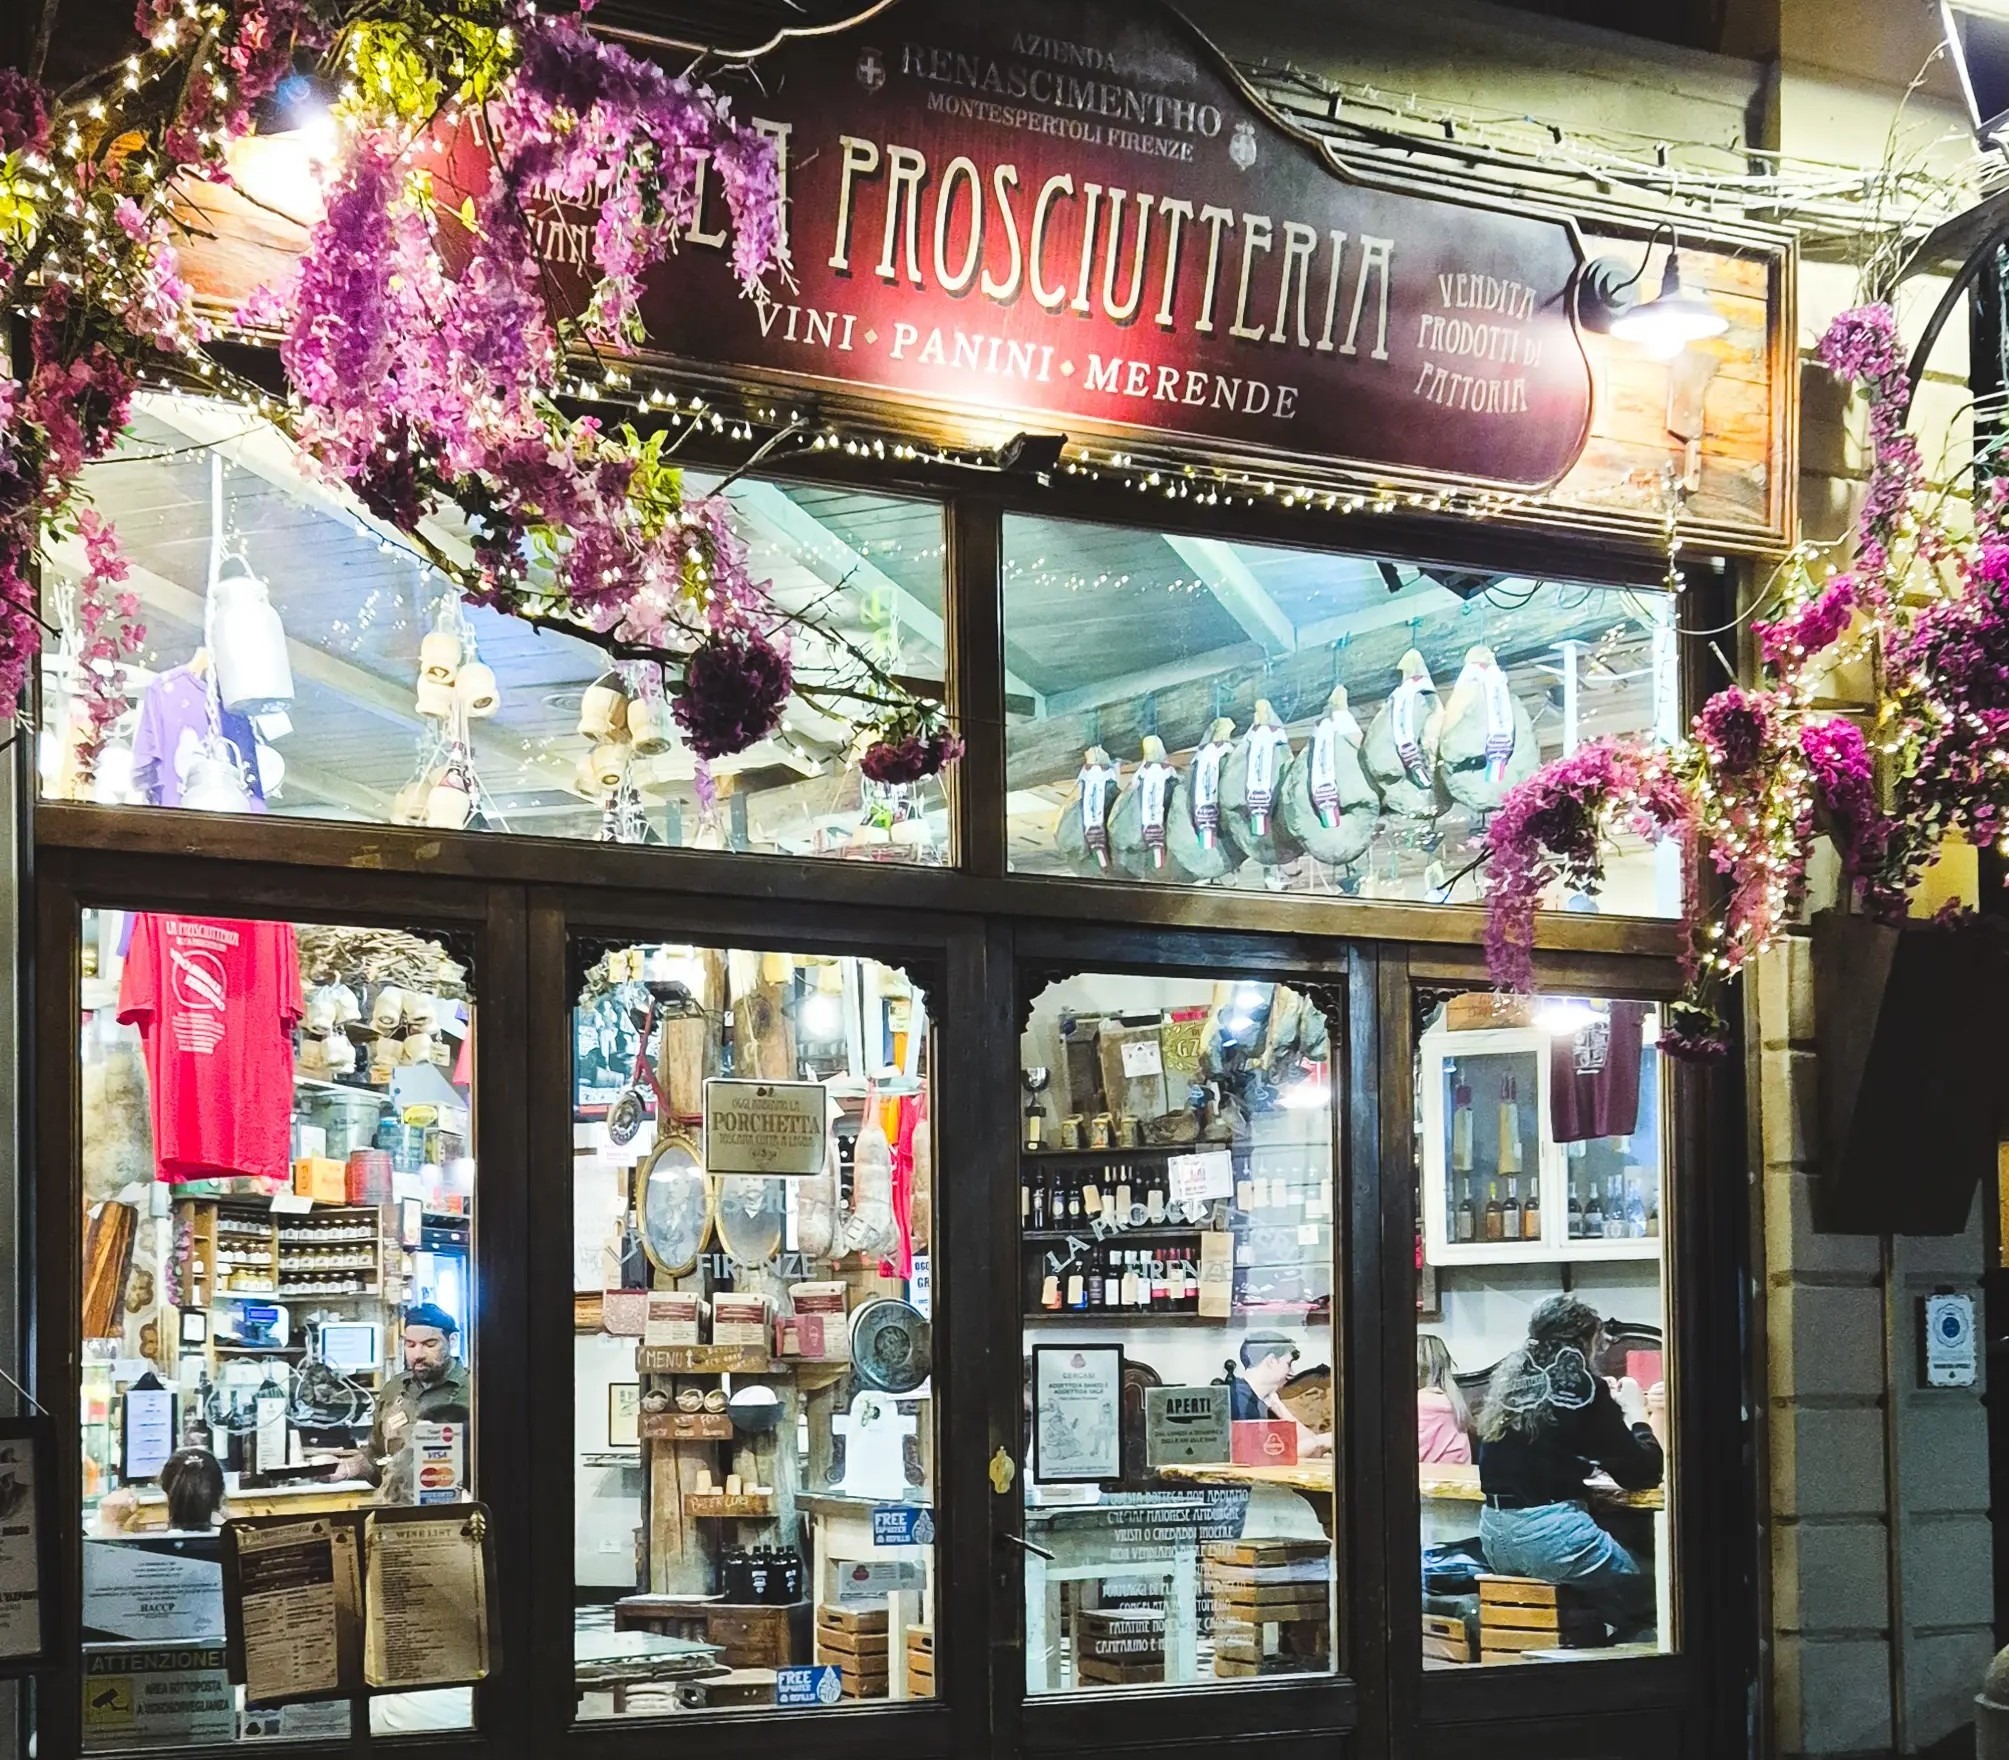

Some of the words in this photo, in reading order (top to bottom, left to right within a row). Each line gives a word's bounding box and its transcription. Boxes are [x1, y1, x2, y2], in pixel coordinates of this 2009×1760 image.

[1011, 32, 1118, 75] AZIENDA
[902, 42, 1222, 138] RENASCIMENTHO
[928, 91, 1101, 145] MONTESPERTOLI
[1107, 127, 1194, 163] FIRENZE
[828, 134, 1395, 361] PROSCIUTTERIA
[1437, 271, 1537, 322] VENDITA
[755, 299, 856, 351] VINI
[890, 322, 1055, 382] PANINI
[1083, 353, 1299, 420] MERENDE
[1416, 313, 1520, 365] PRODOTTI
[1413, 361, 1529, 414] FATTORIA
[711, 1111, 821, 1134] PORCHETTA
[1045, 1234, 1091, 1273] LA
[645, 1349, 683, 1369] MENU
[1166, 1398, 1211, 1414] APERTI
[427, 1451, 448, 1459] VISA
[875, 1512, 907, 1526] FREE
[140, 1602, 176, 1612] HACCP
[777, 1670, 812, 1686] FREE
